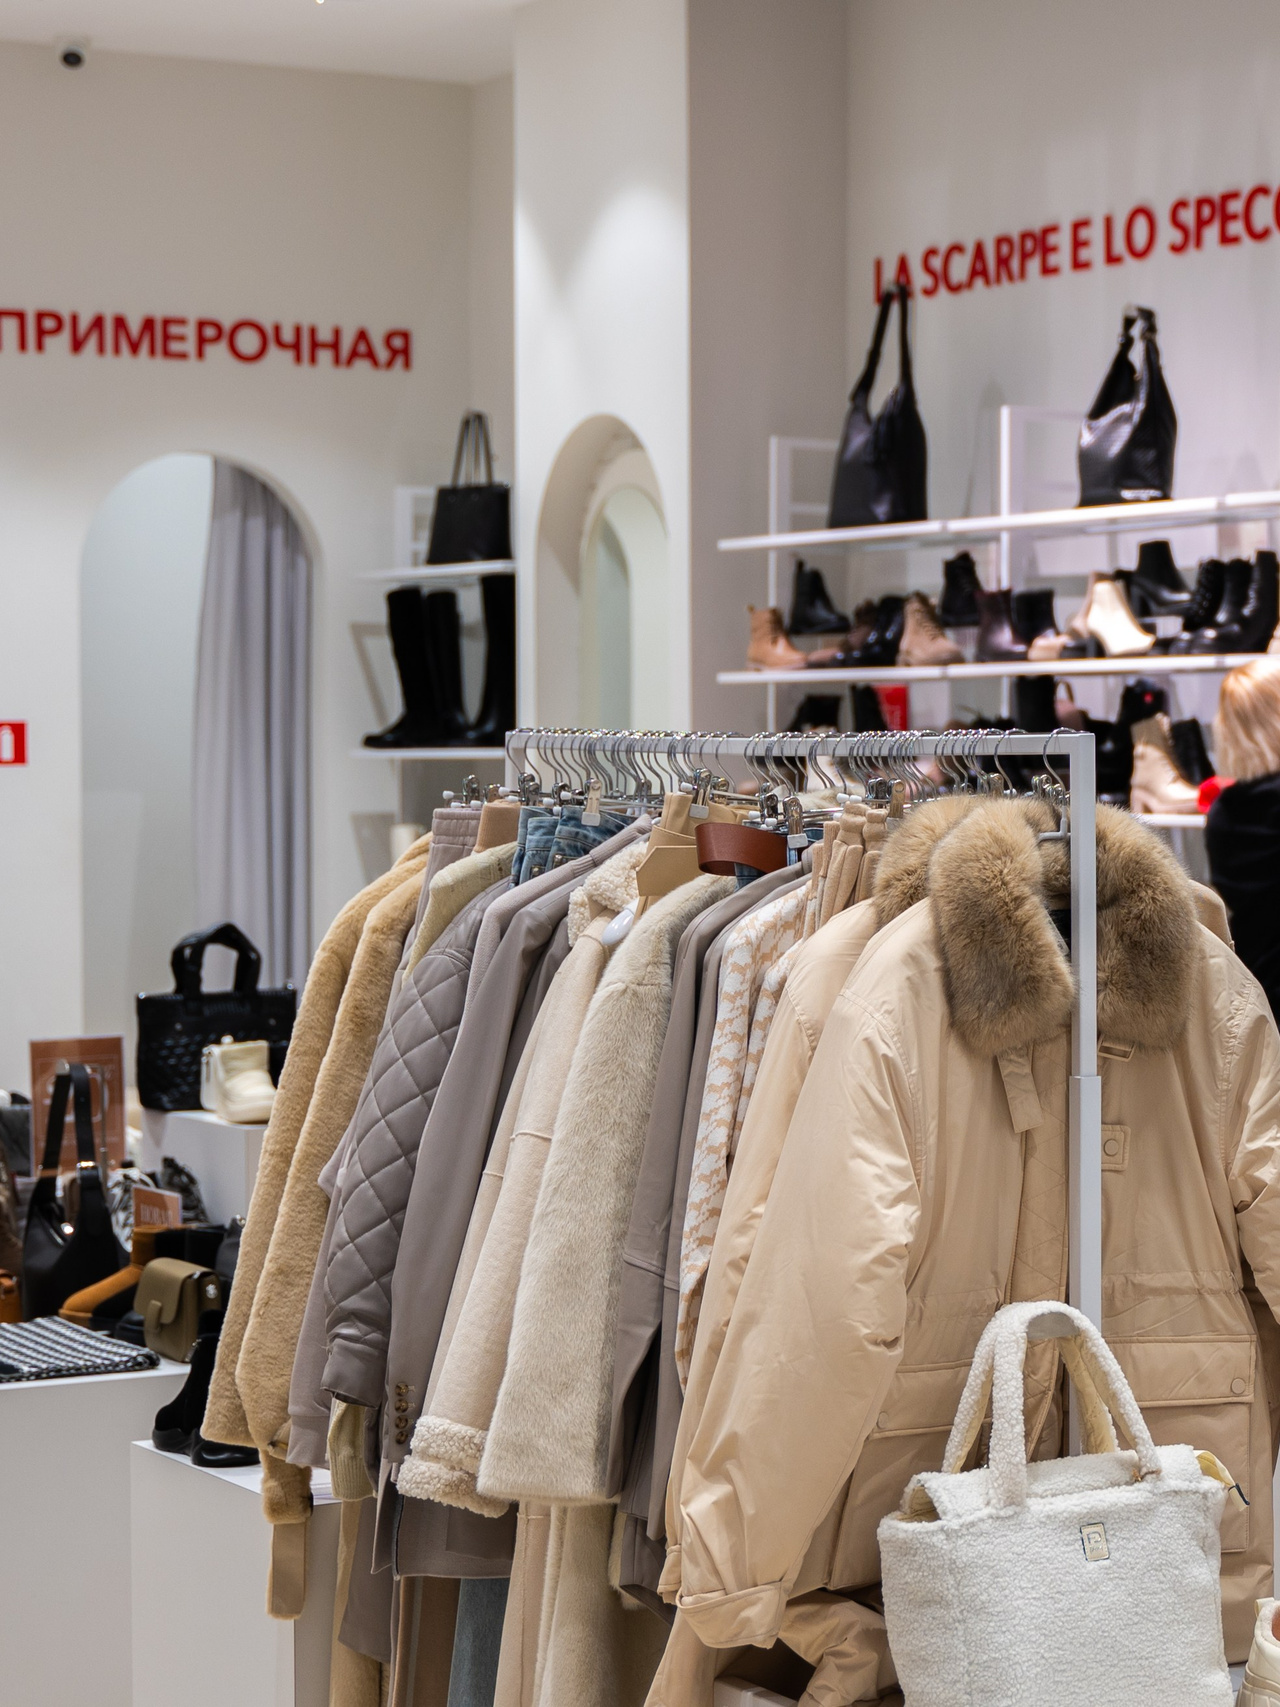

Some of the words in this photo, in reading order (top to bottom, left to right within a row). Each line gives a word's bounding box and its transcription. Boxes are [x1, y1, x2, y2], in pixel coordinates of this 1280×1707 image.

[921, 219, 1061, 297] SCARPE
[1069, 217, 1092, 271] E
[1104, 205, 1158, 266] LO
[0, 308, 413, 372] ПРИМЕРОЧНАЯ
